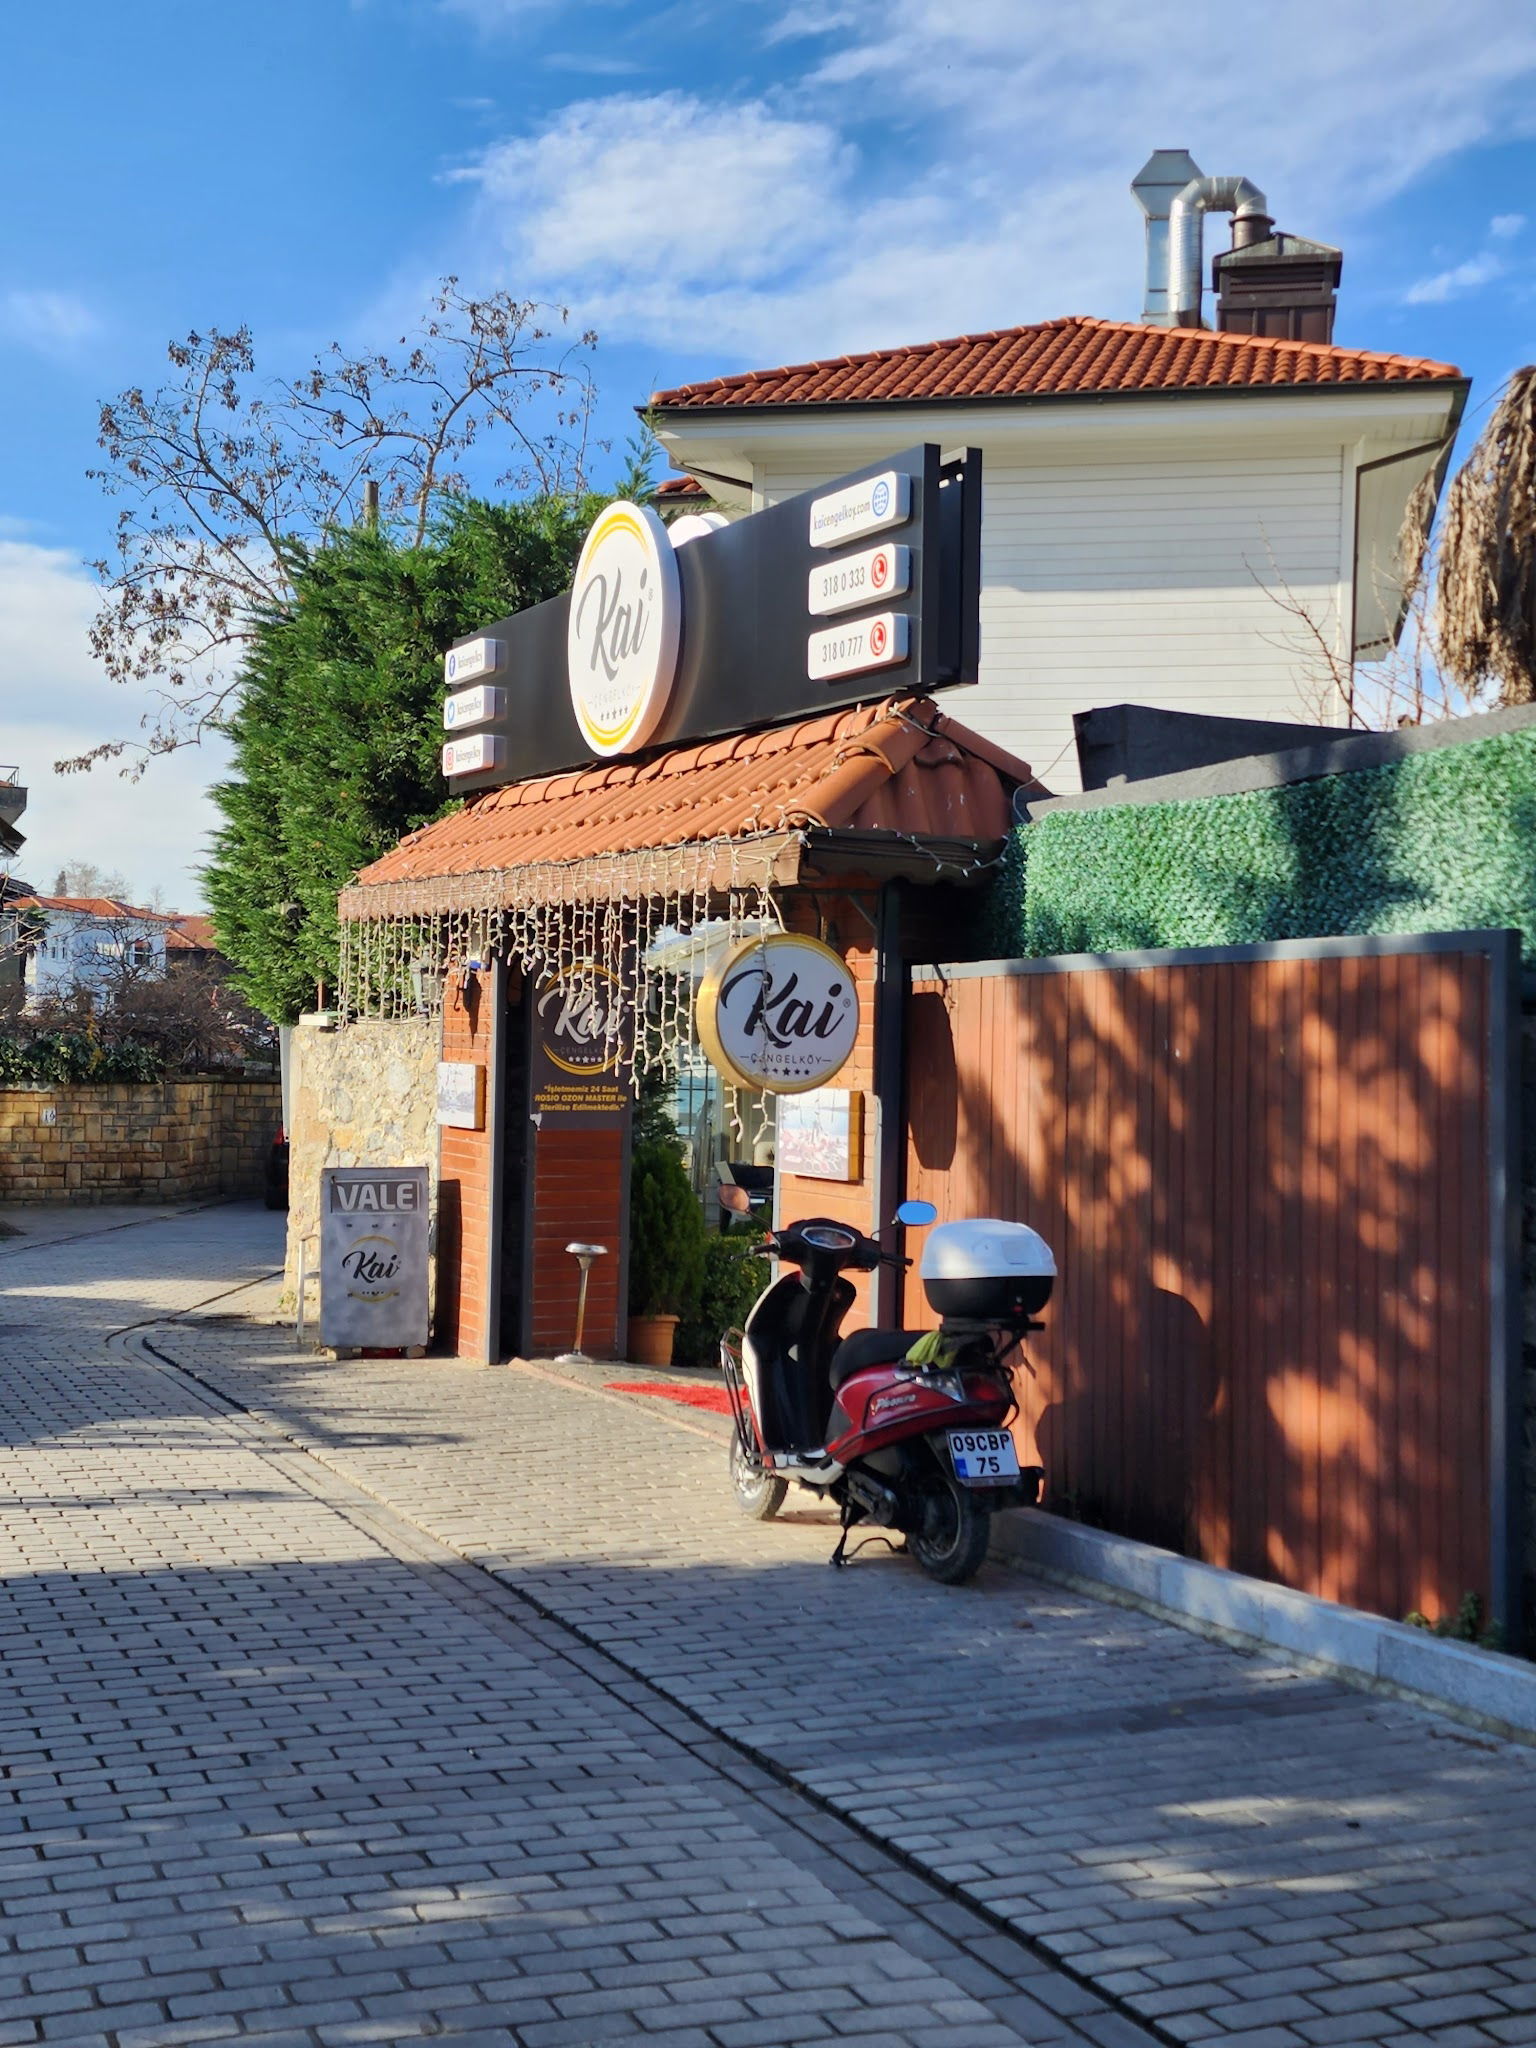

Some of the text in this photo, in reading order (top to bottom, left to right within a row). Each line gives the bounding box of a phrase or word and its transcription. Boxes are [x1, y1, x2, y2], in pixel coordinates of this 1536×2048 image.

[823, 566, 866, 598] 318 0 333
[576, 567, 650, 682] Kai
[822, 635, 864, 663] 318 0 777
[538, 987, 626, 1044] Kai
[720, 969, 845, 1049] Kai
[561, 1094, 583, 1102] OZON
[585, 1094, 616, 1102] MASTER
[336, 1184, 414, 1211] VALE
[342, 1251, 401, 1284] Kai
[952, 1434, 1010, 1453] 09CBP
[976, 1456, 1001, 1475] 75
